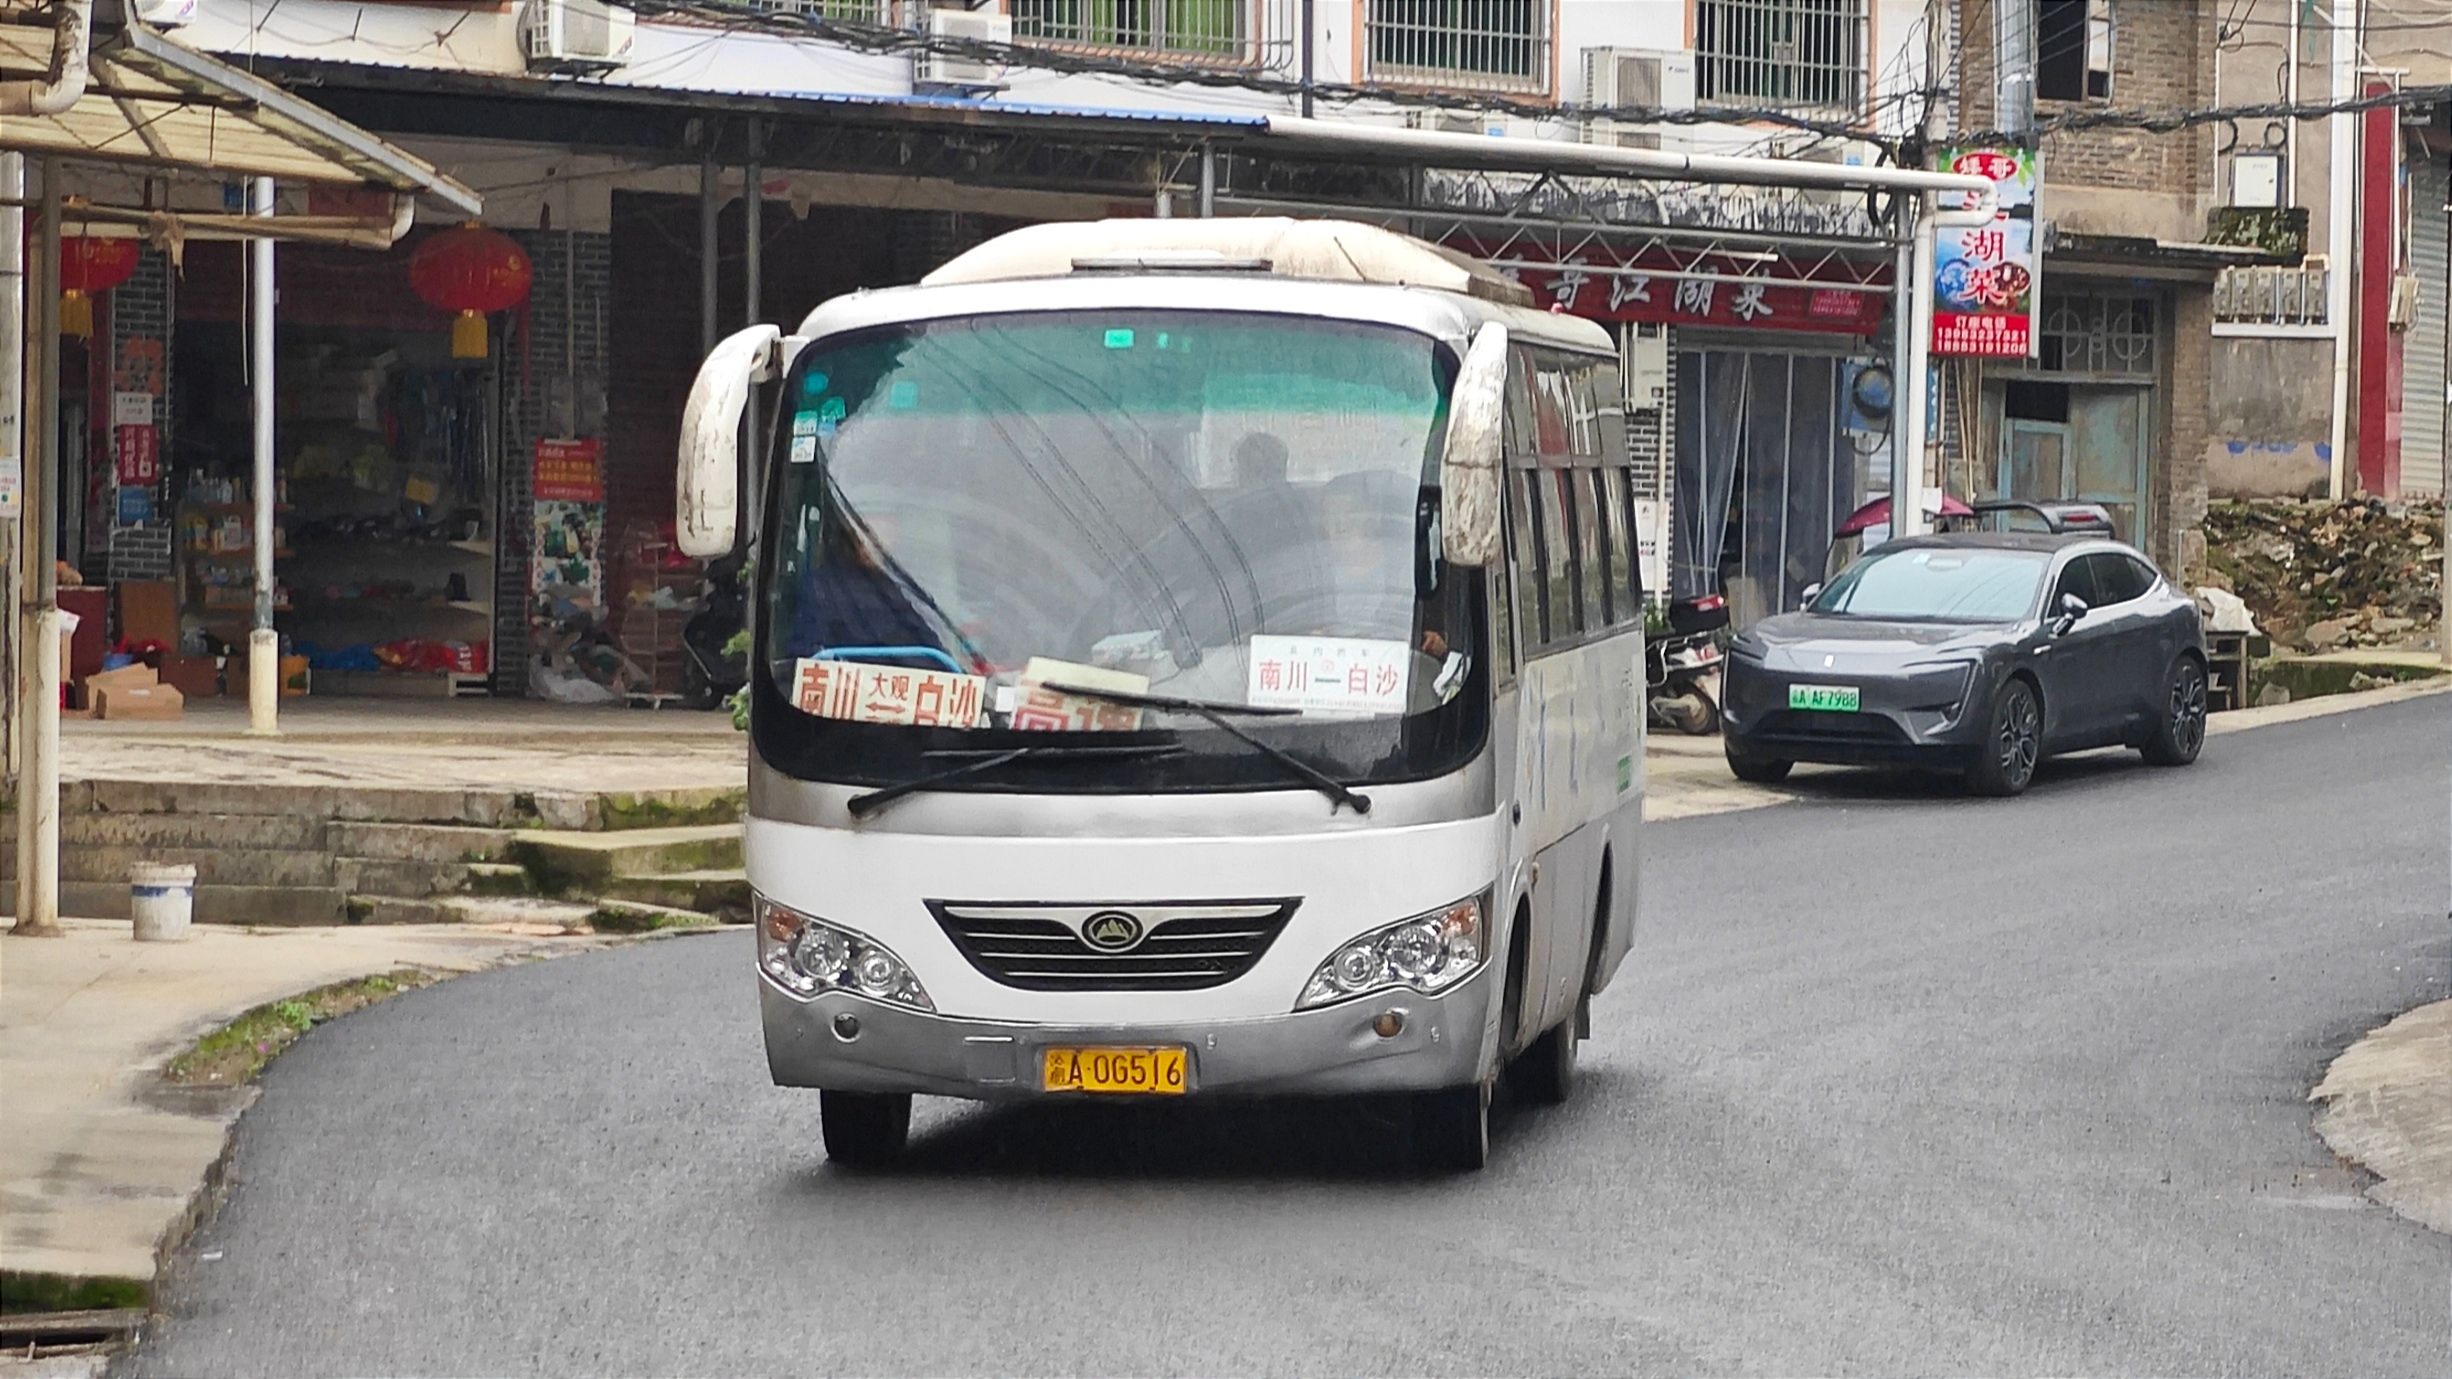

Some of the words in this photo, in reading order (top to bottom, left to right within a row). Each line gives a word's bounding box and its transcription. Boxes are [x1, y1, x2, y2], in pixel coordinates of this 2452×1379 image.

[868, 672, 910, 701] 大观
[1259, 659, 1308, 692] 南川
[1348, 663, 1398, 696] 白沙
